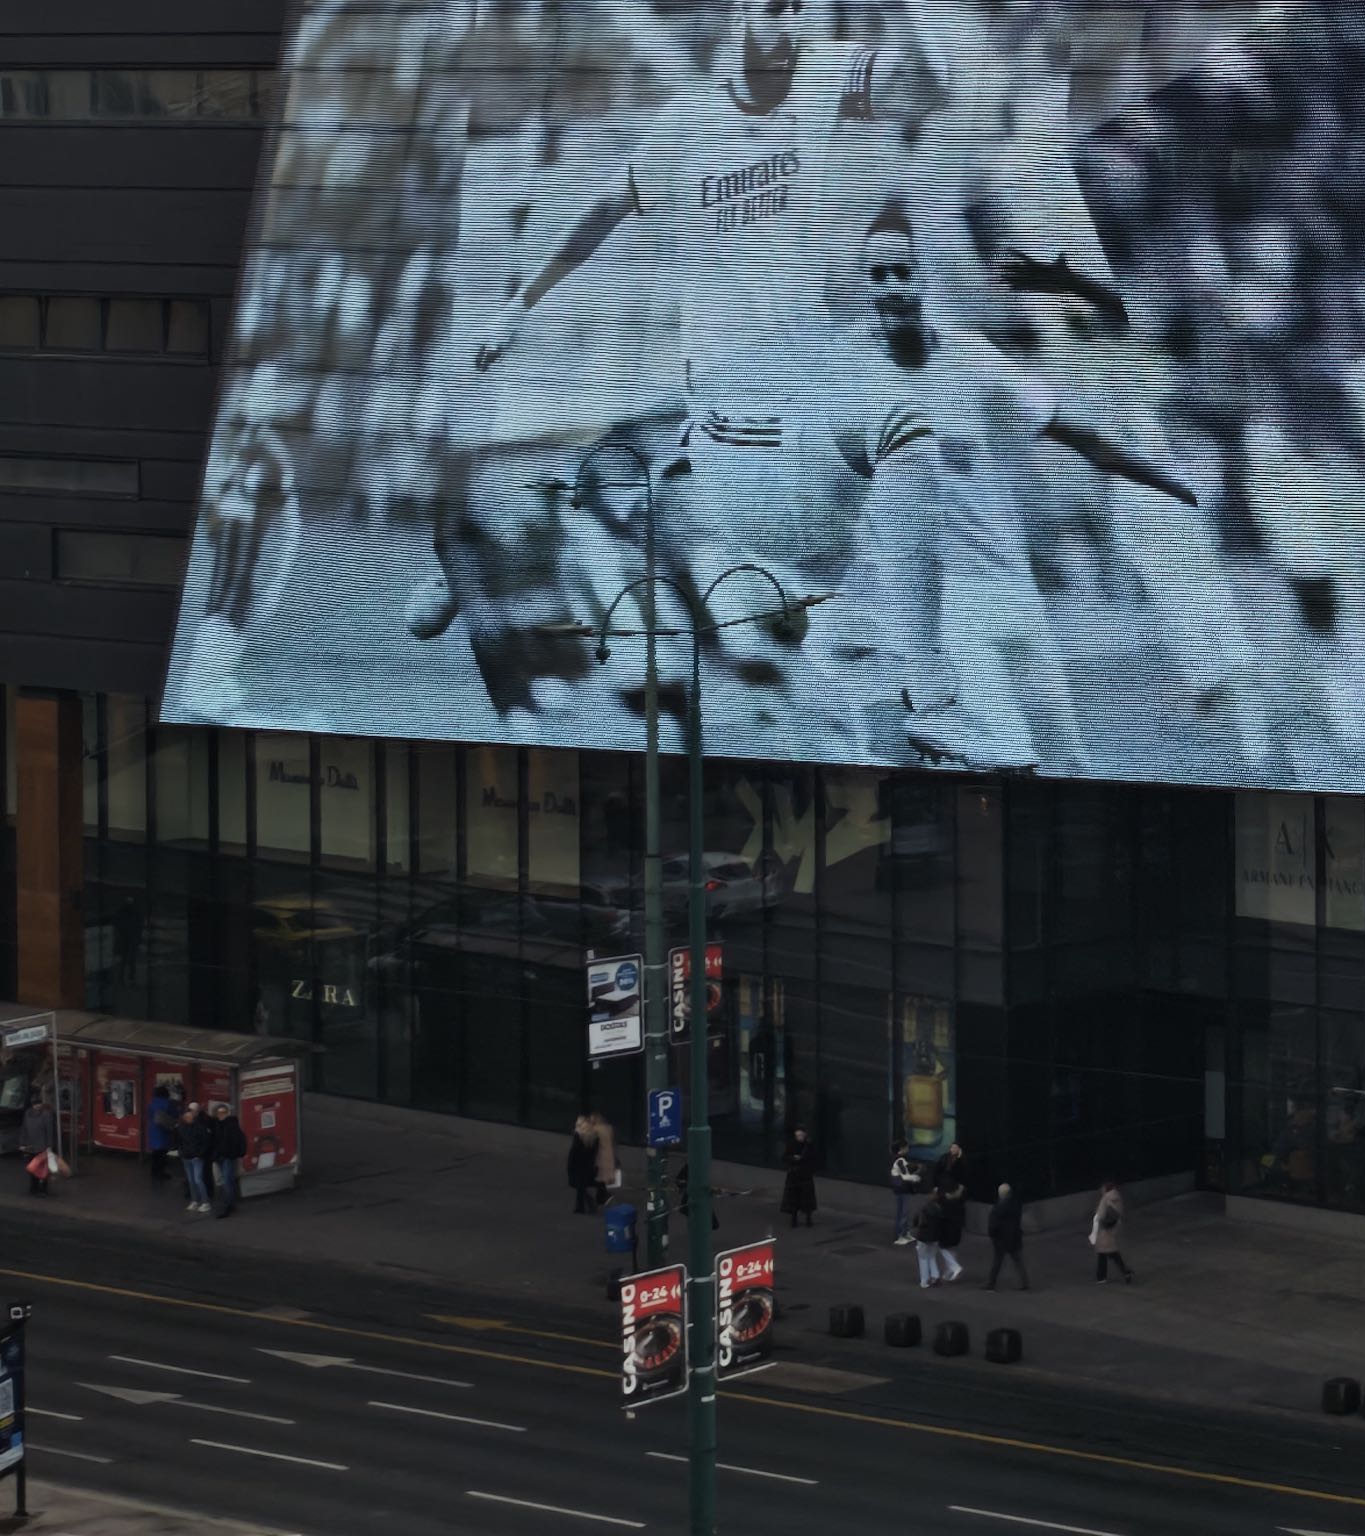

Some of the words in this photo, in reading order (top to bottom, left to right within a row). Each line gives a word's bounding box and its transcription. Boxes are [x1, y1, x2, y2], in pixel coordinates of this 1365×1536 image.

[290, 979, 360, 1007] ZRA
[672, 953, 686, 1033] CASINO
[658, 1096, 673, 1118] P
[621, 1283, 638, 1396] CASINO
[719, 1258, 734, 1368] CASINO
